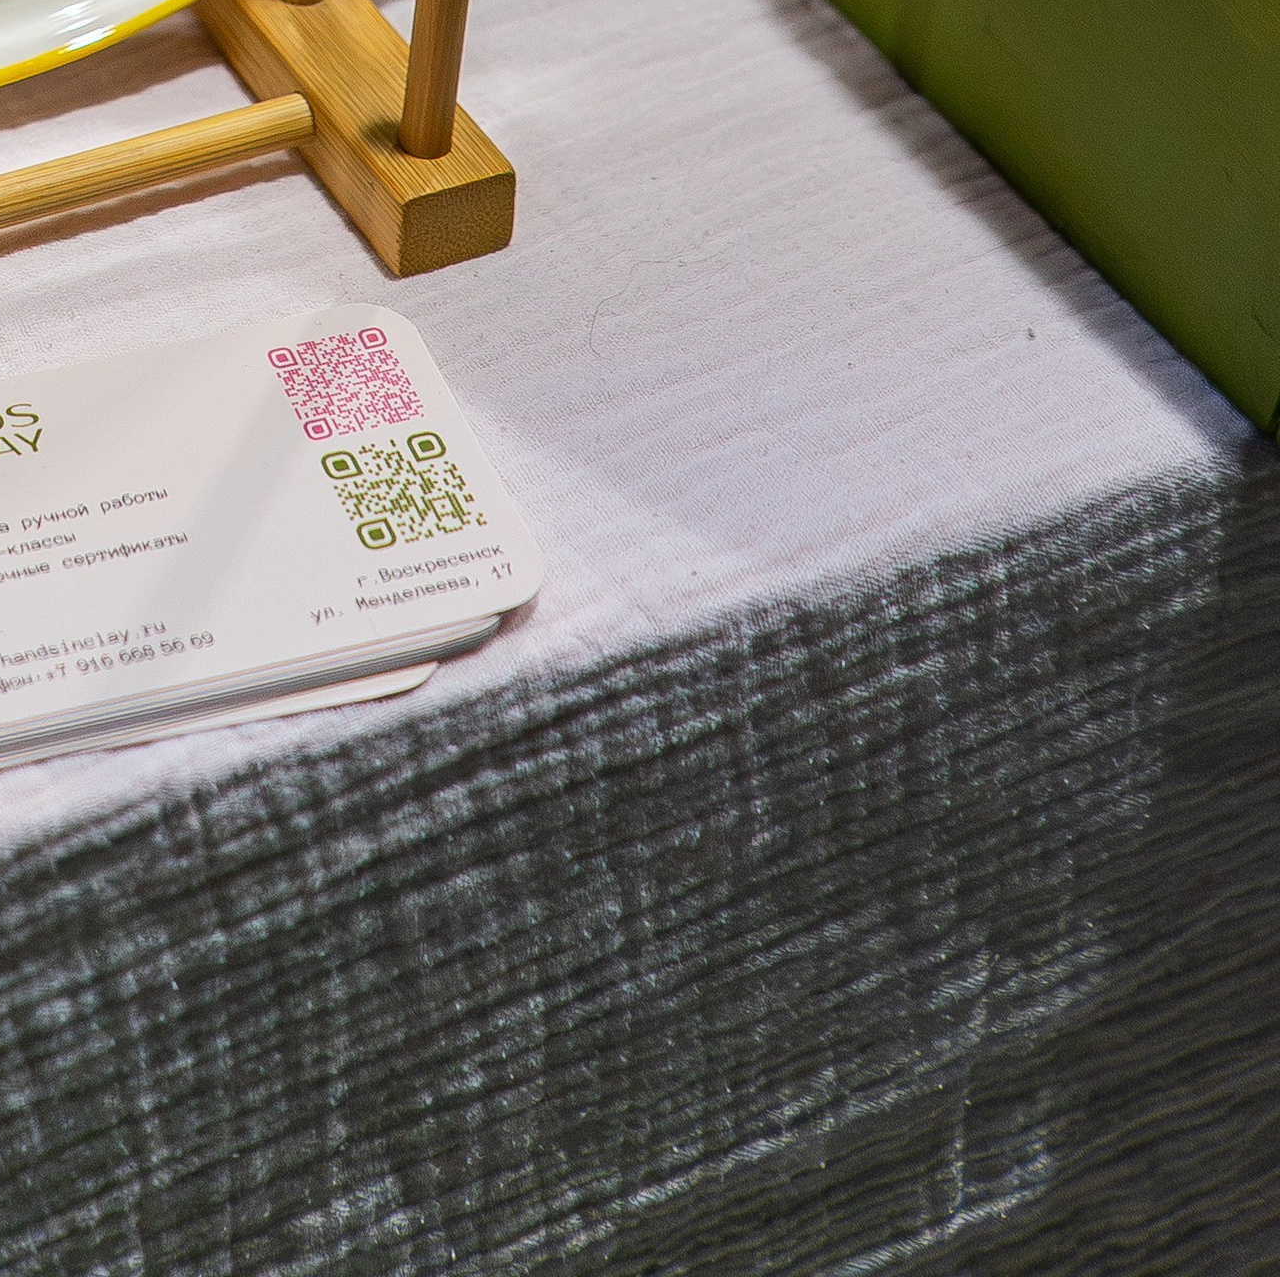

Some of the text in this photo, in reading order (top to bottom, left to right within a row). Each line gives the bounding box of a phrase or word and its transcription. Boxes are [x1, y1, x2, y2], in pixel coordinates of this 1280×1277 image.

[20, 503, 89, 532] ручной
[99, 488, 168, 515] работы
[61, 531, 189, 570] сертификаты
[490, 562, 515, 581] 17
